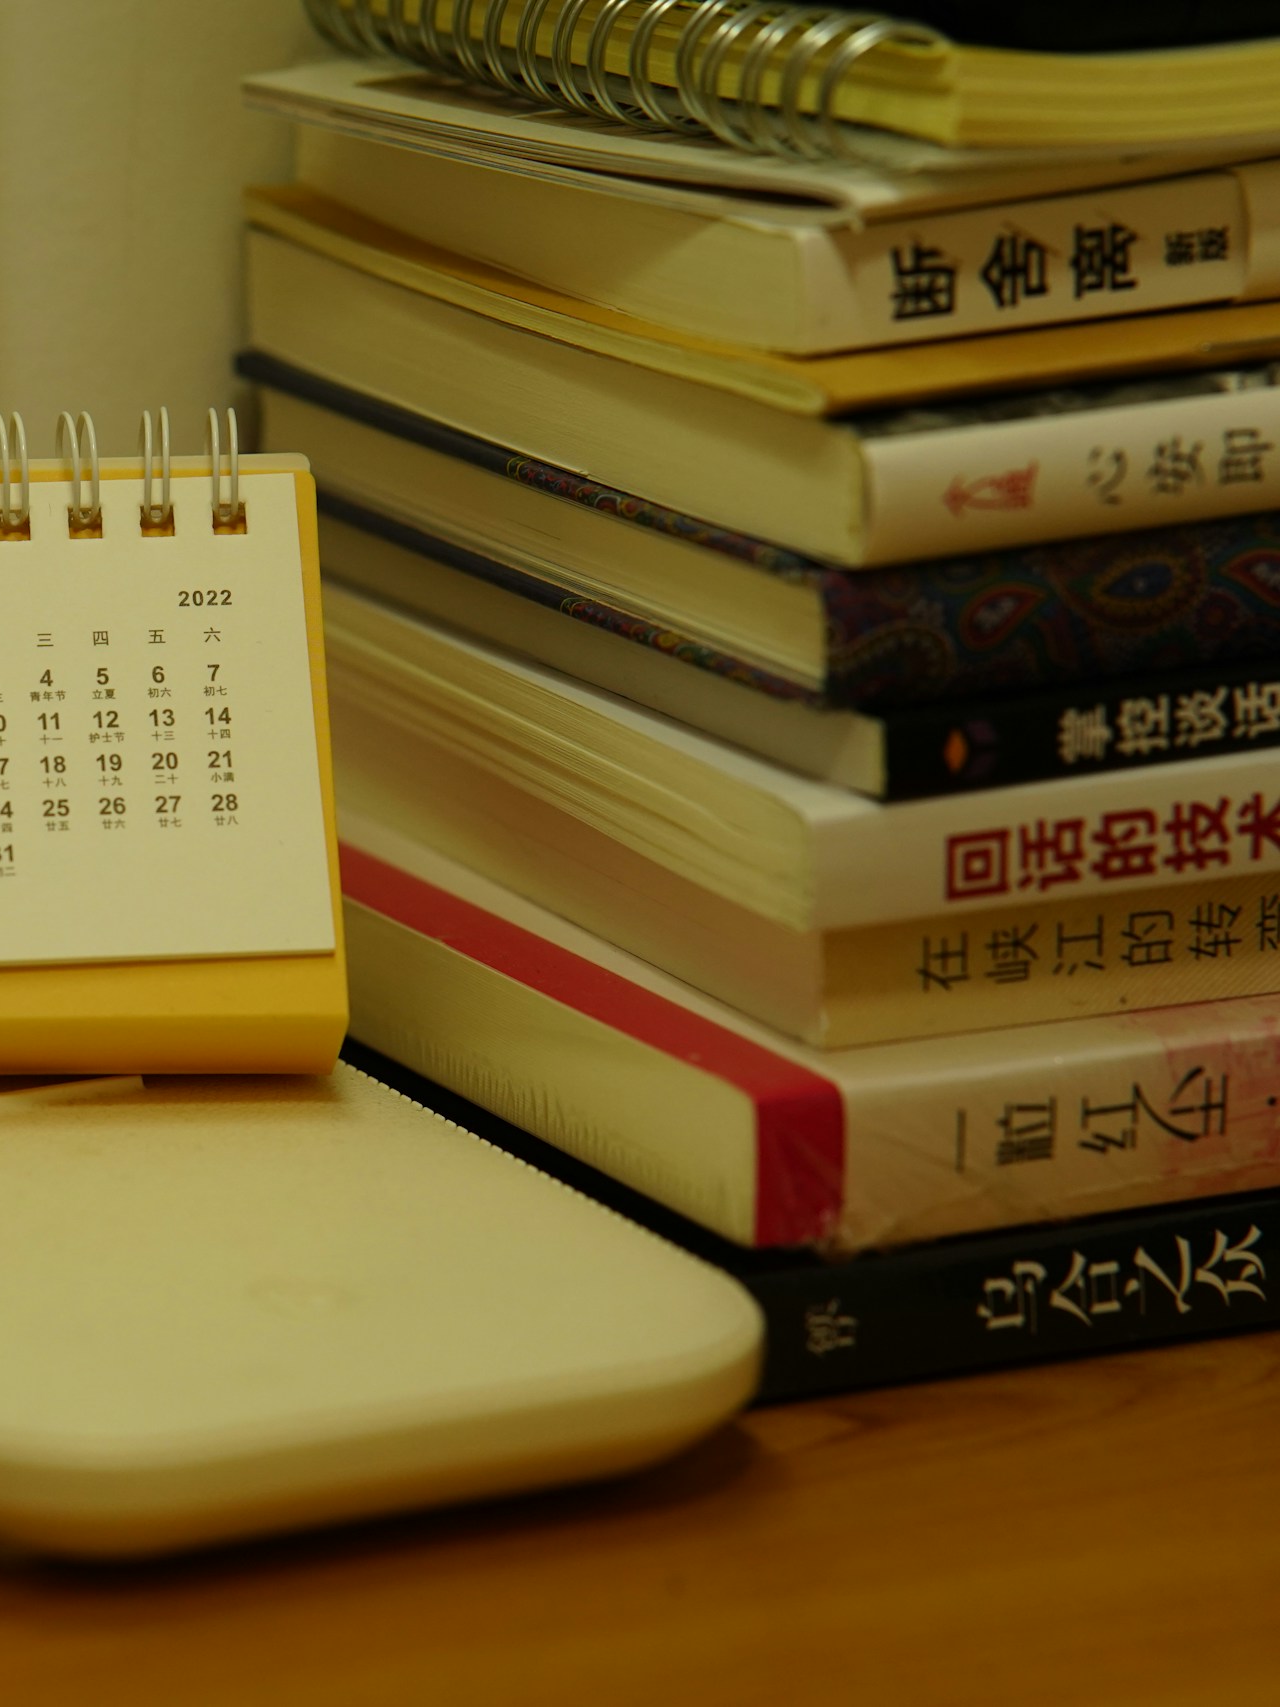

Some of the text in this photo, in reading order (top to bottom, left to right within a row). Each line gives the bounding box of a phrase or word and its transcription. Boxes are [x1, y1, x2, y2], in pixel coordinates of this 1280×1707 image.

[891, 222, 1138, 321] 断舍离
[178, 589, 233, 607] 2022
[36, 633, 55, 648] 三
[92, 630, 110, 647] 四
[148, 629, 167, 644] 五
[203, 626, 221, 643] 六
[39, 668, 54, 687] 4
[96, 667, 110, 686] 5
[151, 665, 165, 684] 6
[207, 663, 220, 682] 7
[29, 690, 66, 703] 青年节
[92, 688, 116, 700] 立夏
[147, 687, 172, 699] 初六
[203, 685, 228, 697] 初七
[37, 712, 60, 731] 11
[92, 710, 120, 729] 12
[148, 708, 176, 727] 13
[204, 706, 232, 726] 14
[39, 733, 64, 745] 十一
[151, 730, 176, 742] 十三
[207, 728, 231, 740] 十四
[39, 755, 67, 774] 18
[95, 753, 123, 772] 19
[151, 751, 179, 771] 20
[207, 749, 233, 769] 21
[42, 776, 67, 789] 十八
[98, 775, 123, 787] 十九
[154, 773, 179, 785] 二十
[210, 771, 235, 784] 小满
[42, 798, 70, 818] 25
[98, 796, 127, 816] 26
[154, 795, 182, 814] 27
[211, 793, 239, 812] 28
[101, 818, 126, 830] 廿六
[157, 816, 182, 828] 廿七
[213, 815, 239, 827] 廿八
[976, 1225, 1267, 1335] 乌合之众
